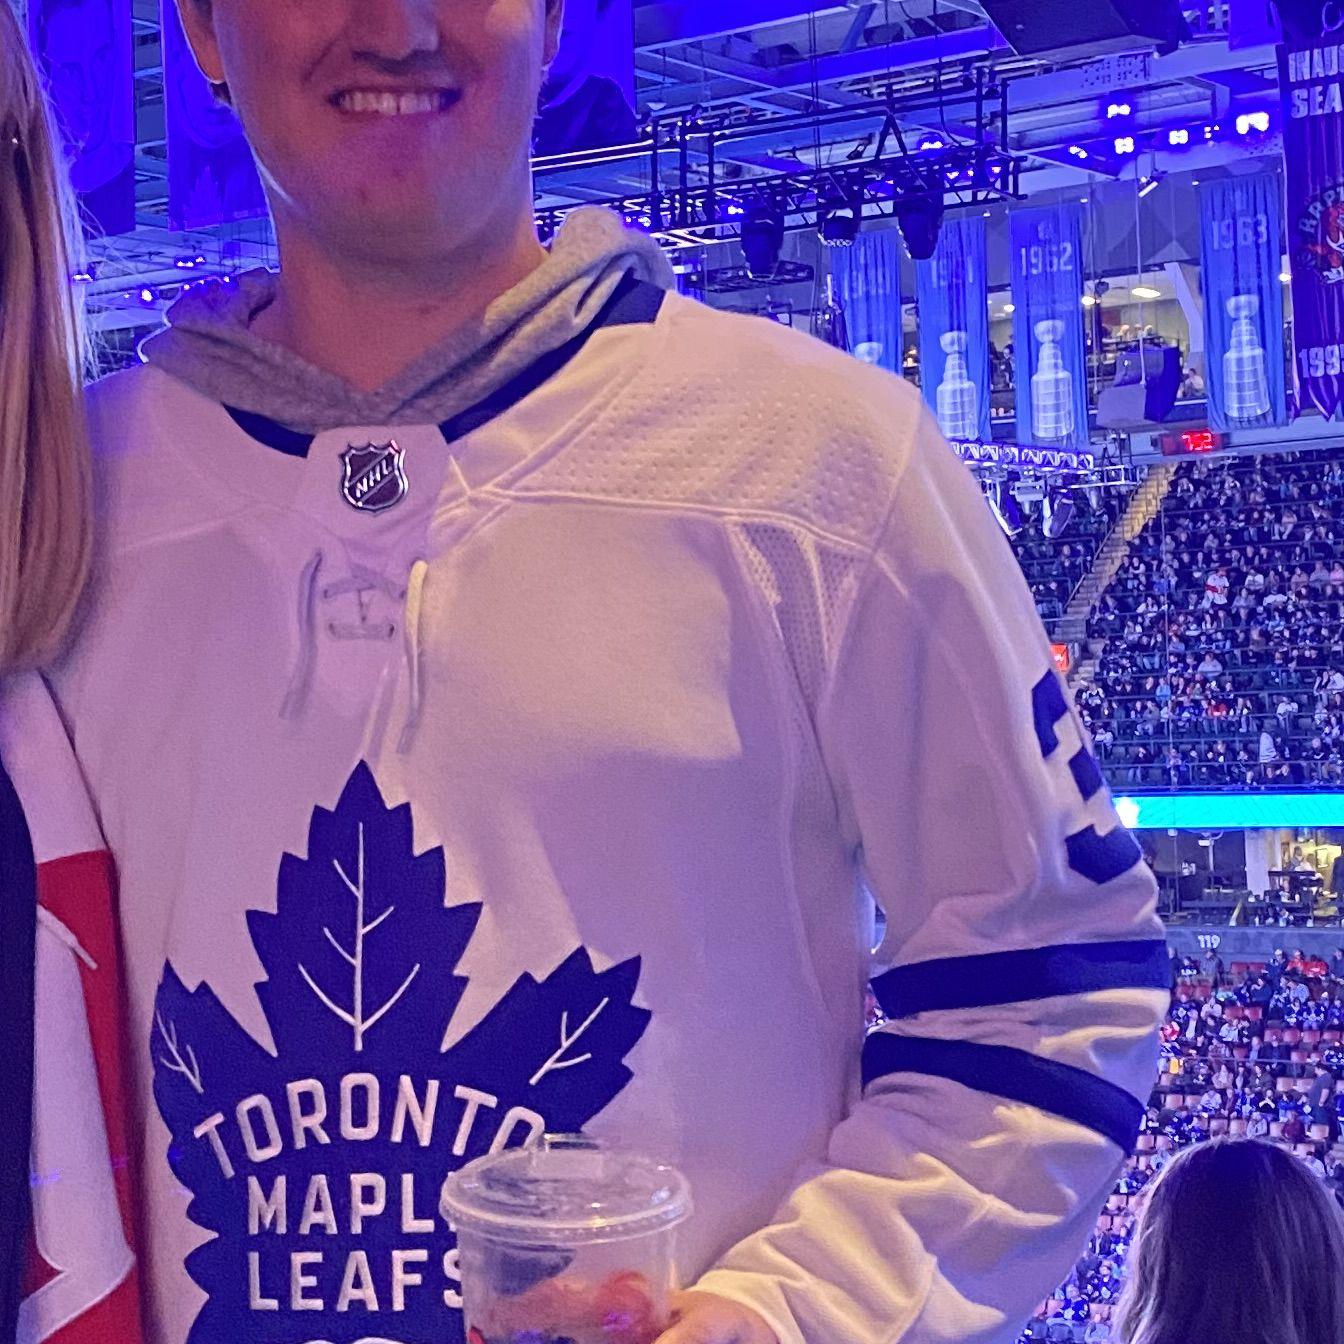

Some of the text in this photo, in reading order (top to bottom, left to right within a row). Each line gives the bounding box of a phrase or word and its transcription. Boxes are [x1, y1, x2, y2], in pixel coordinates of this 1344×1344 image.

[1212, 213, 1267, 250] 1963
[1020, 241, 1073, 277] 1962
[356, 458, 392, 497] NHL
[1197, 934, 1221, 949] 119
[194, 1072, 546, 1180] TORONTO
[248, 1170, 458, 1238] MAPL
